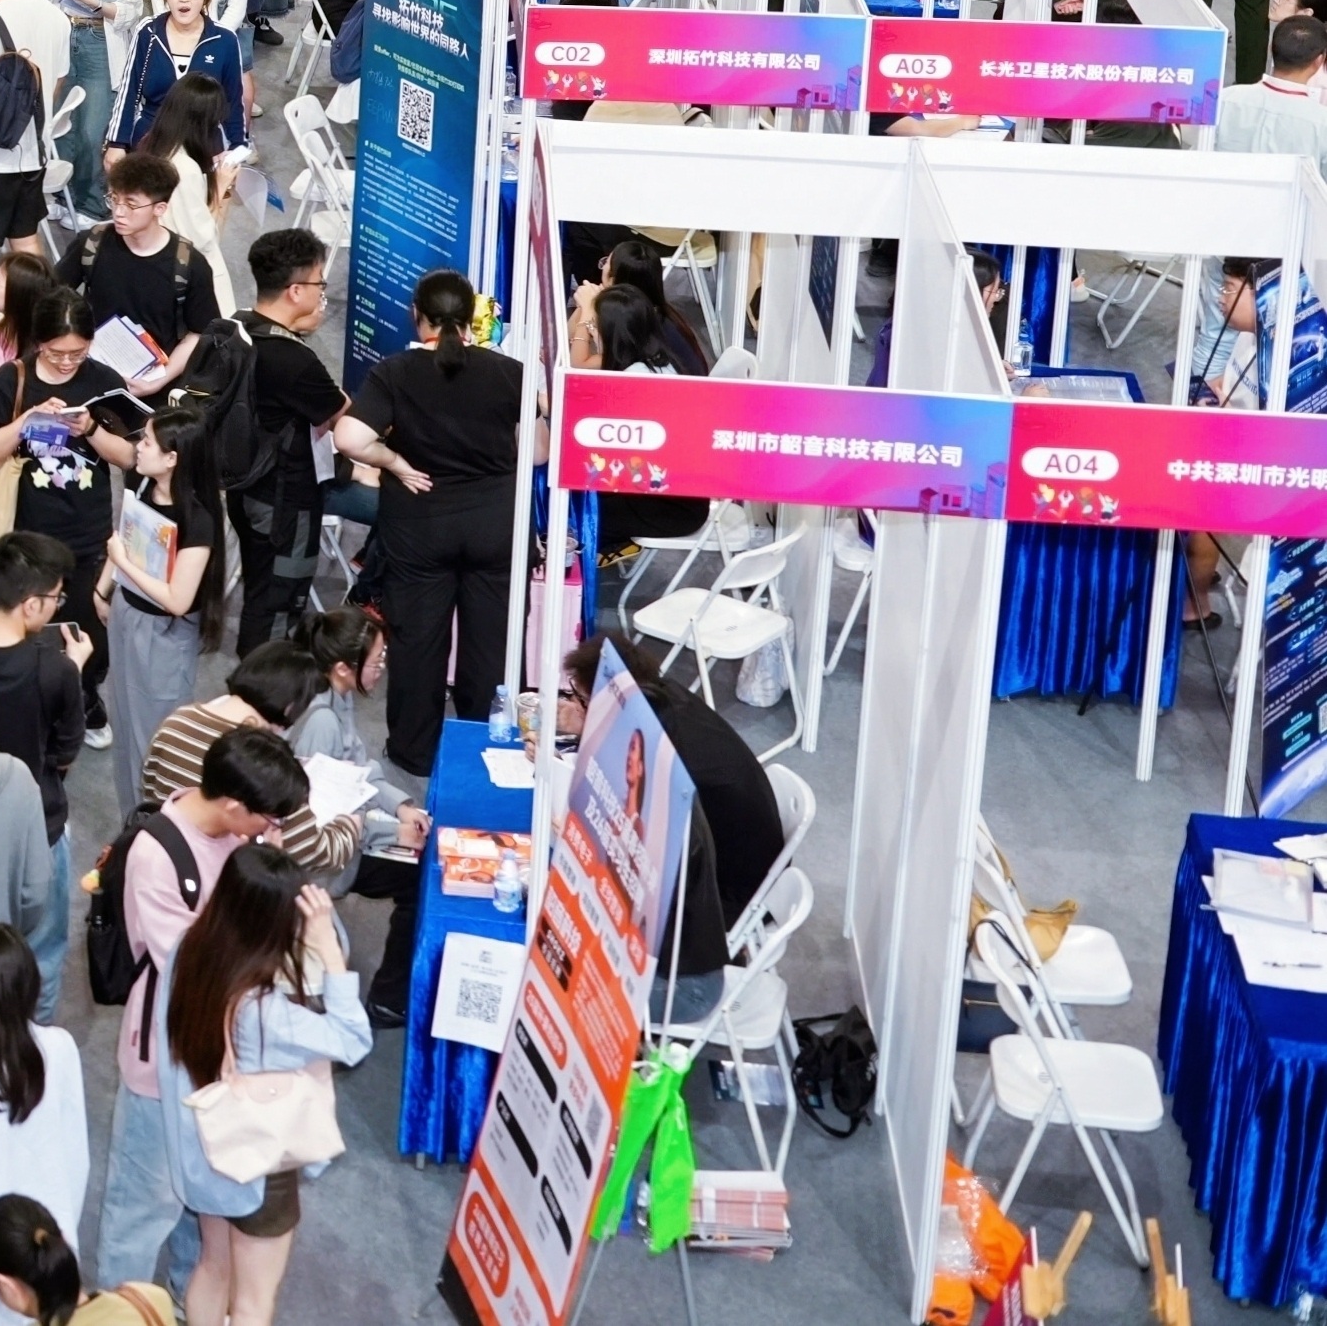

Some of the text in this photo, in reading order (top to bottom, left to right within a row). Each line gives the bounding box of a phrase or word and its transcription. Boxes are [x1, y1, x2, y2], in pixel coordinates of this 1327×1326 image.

[372, 2, 471, 60] 寻找影响世界的同路人
[549, 45, 821, 71] C02 深圳拓竹科技有限公司
[894, 58, 1194, 86] A03 长光卫星技术股份有限公司
[598, 423, 963, 468] C01 深圳市韶音科技有限公司
[1044, 452, 1099, 474] A04
